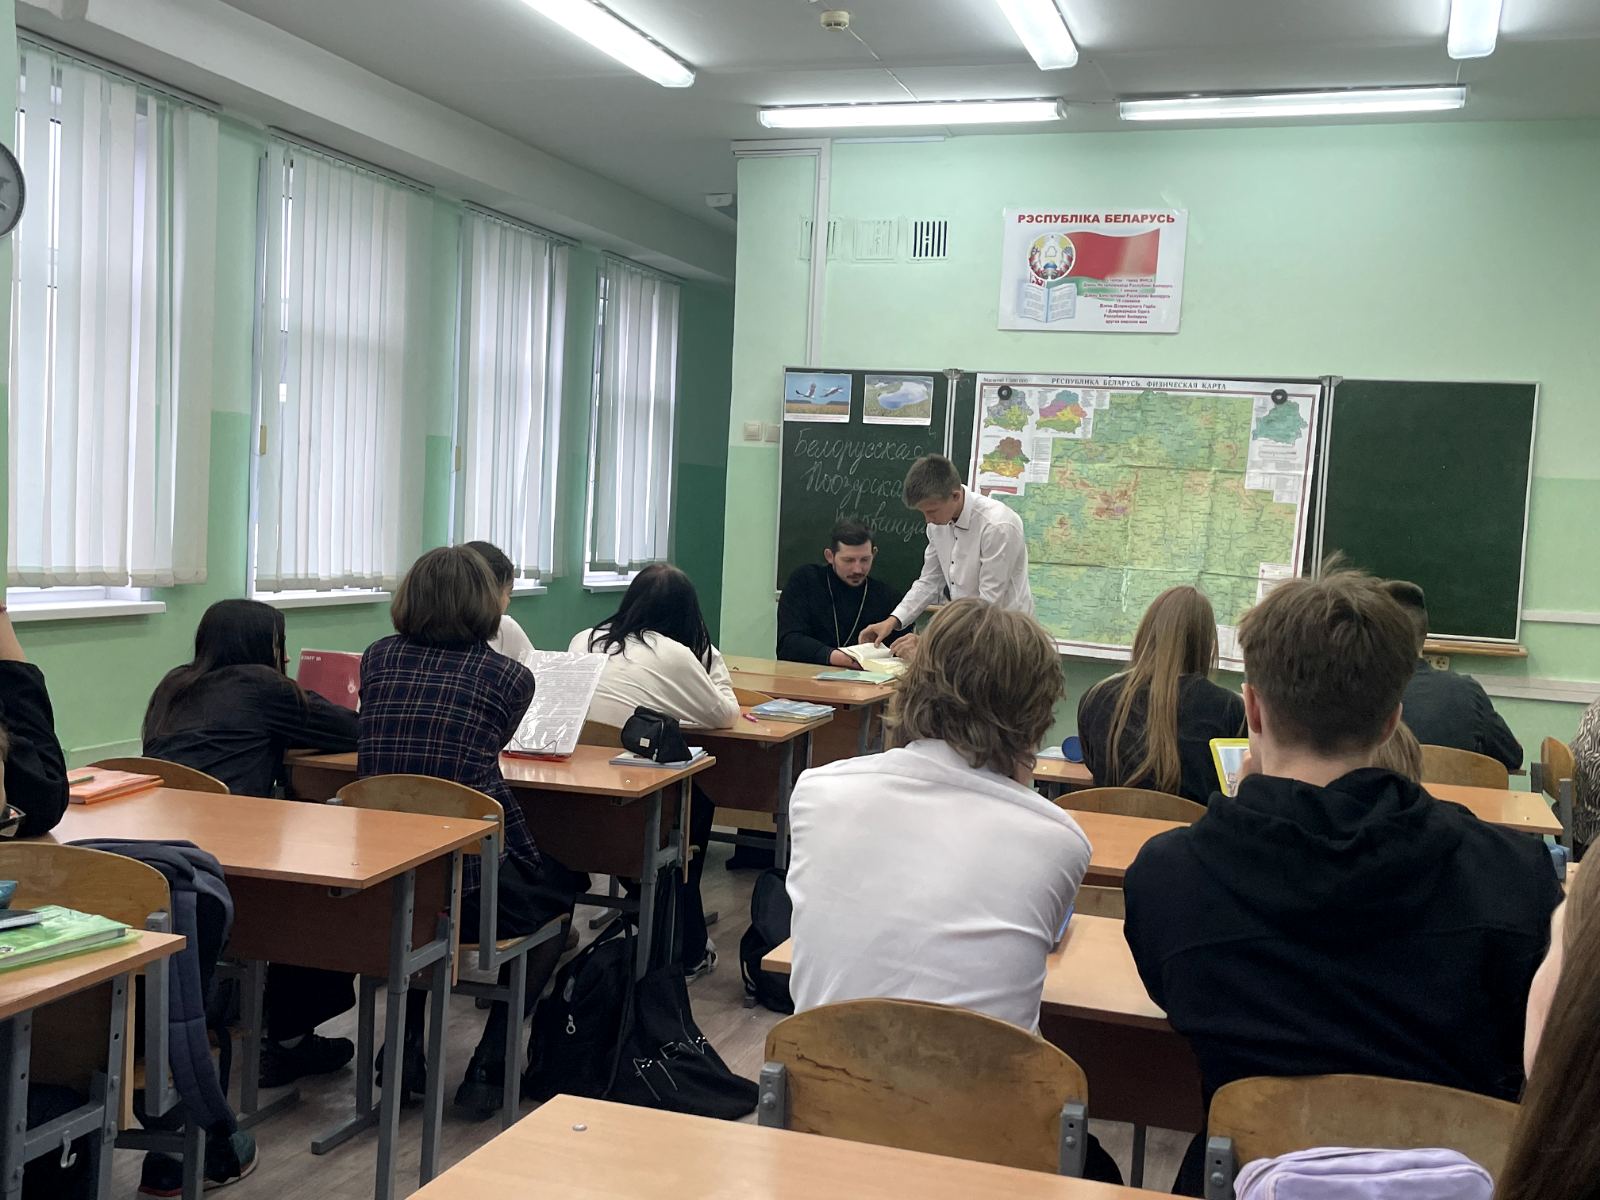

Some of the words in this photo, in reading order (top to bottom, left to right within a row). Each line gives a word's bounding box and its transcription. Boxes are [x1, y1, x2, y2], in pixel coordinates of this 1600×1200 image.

[1017, 214, 1100, 223] РЭСПУБЛІКА
[1104, 214, 1175, 224] БЕЛАРУСЬ
[1051, 377, 1099, 386] РЕСПУБЛИКА
[1146, 380, 1198, 389] ФИЗИЧЕСКАЯ
[1201, 381, 1227, 390] КАРТА
[800, 460, 903, 510] Поозерска
